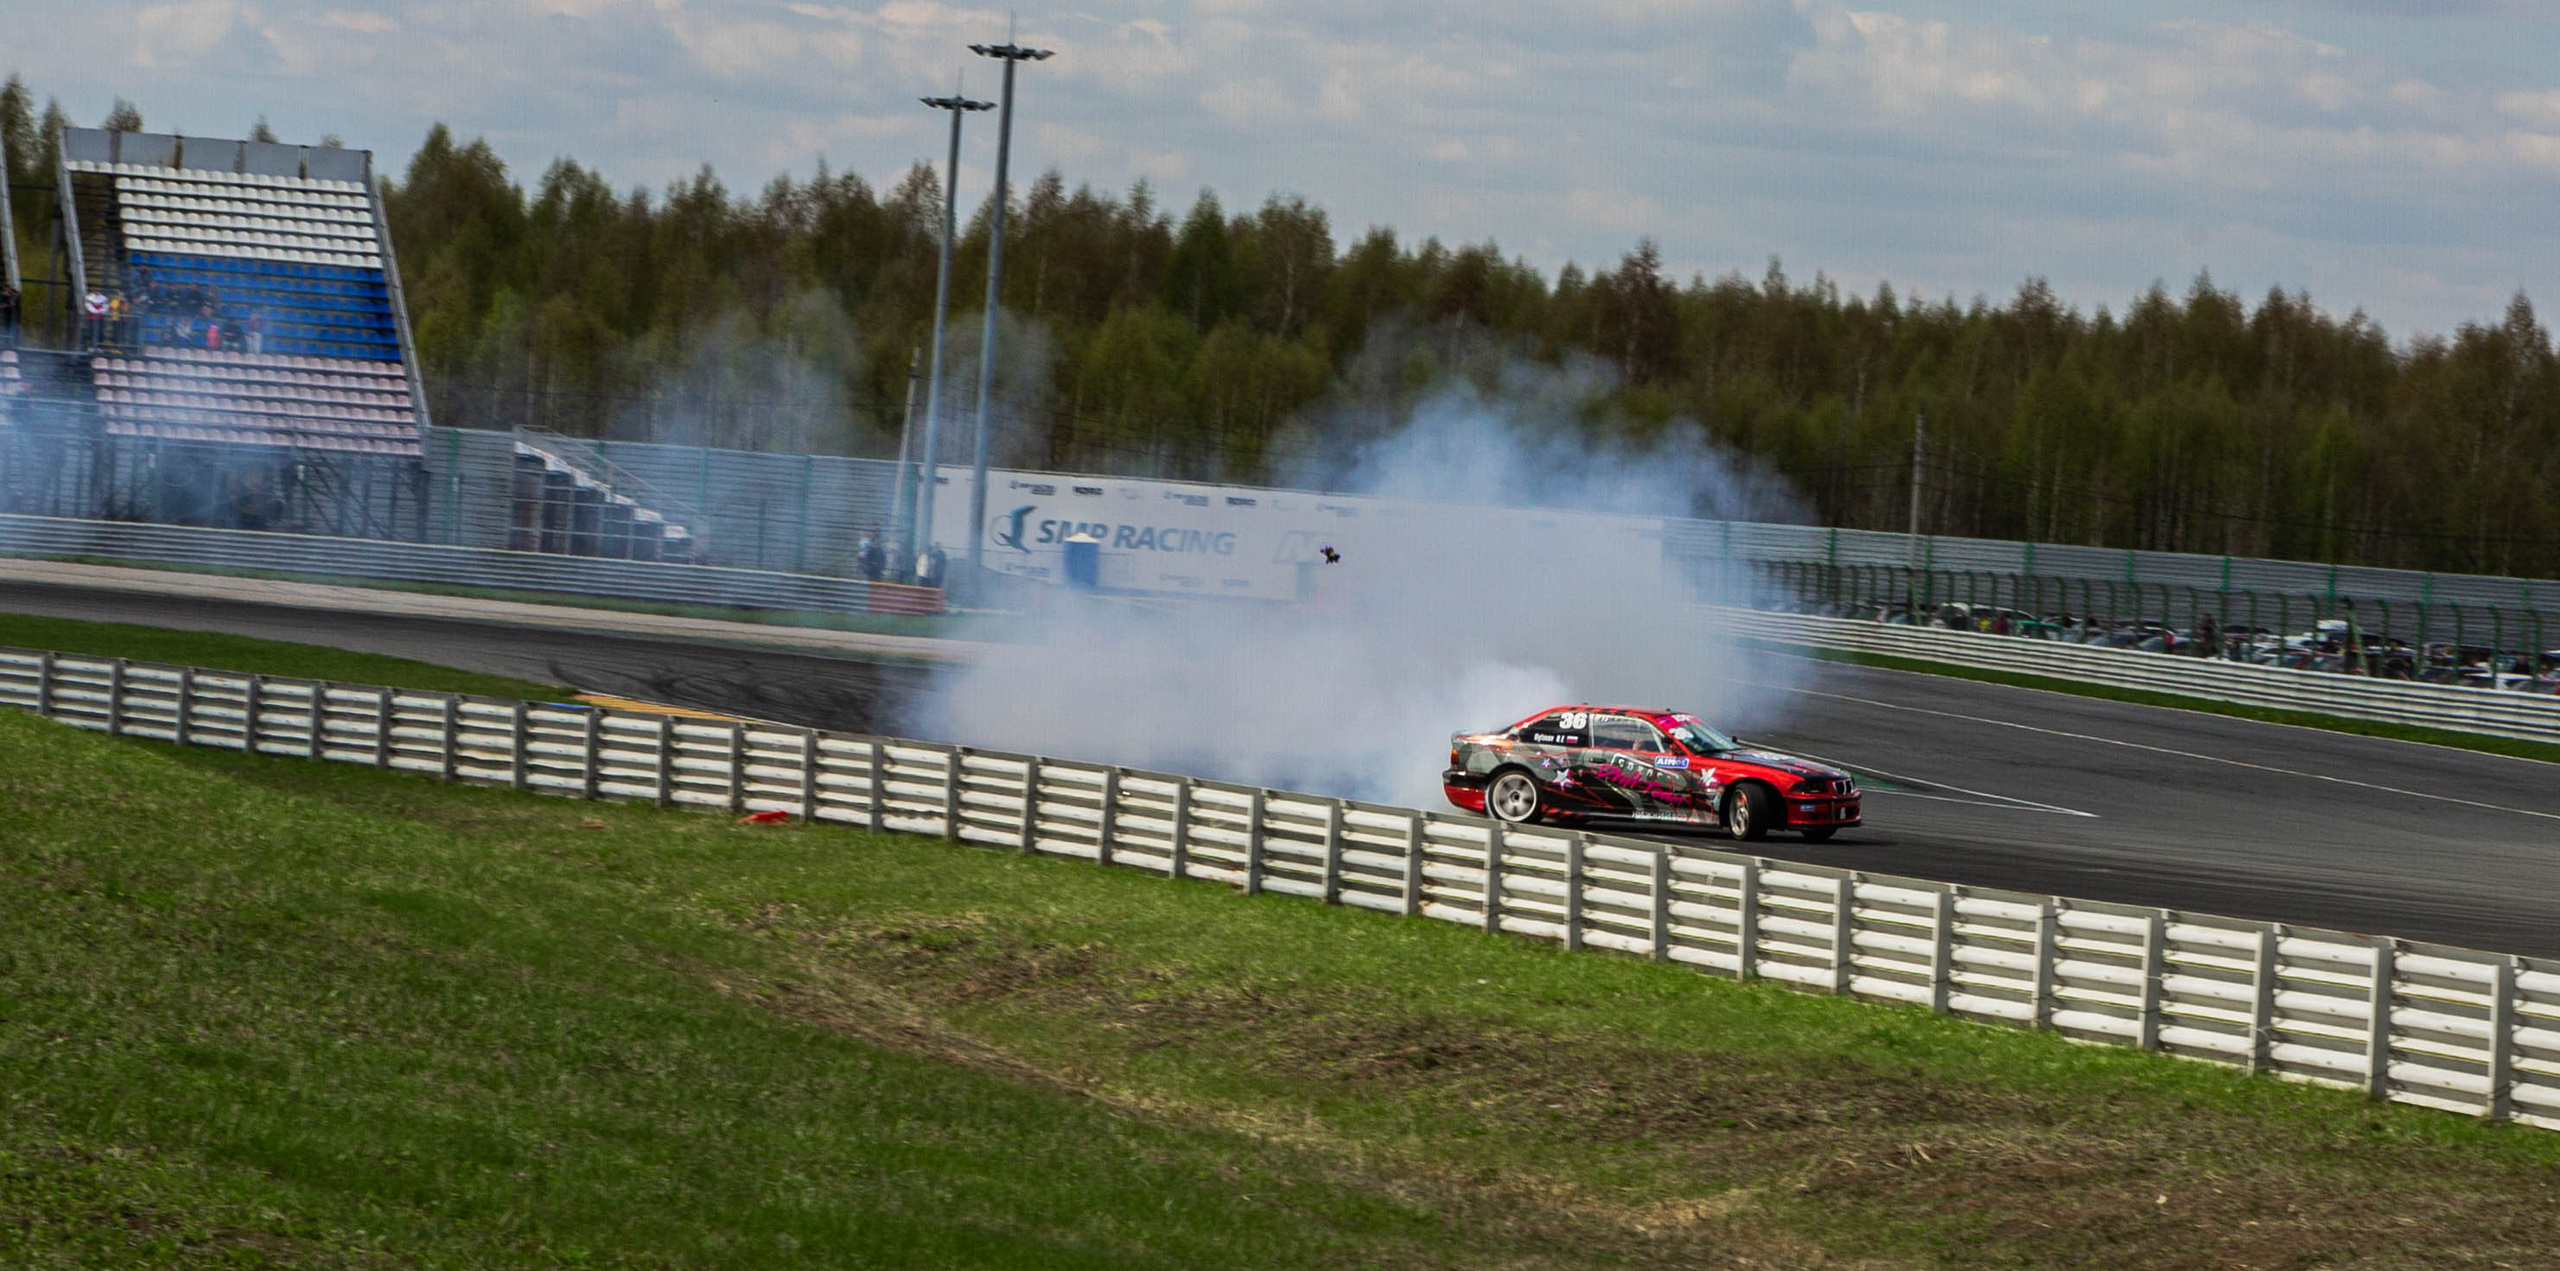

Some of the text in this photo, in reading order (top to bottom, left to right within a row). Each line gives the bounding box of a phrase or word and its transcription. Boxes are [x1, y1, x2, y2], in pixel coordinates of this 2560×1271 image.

[1036, 519, 1237, 556] SMP RACING
[1559, 712, 1587, 730] 36
